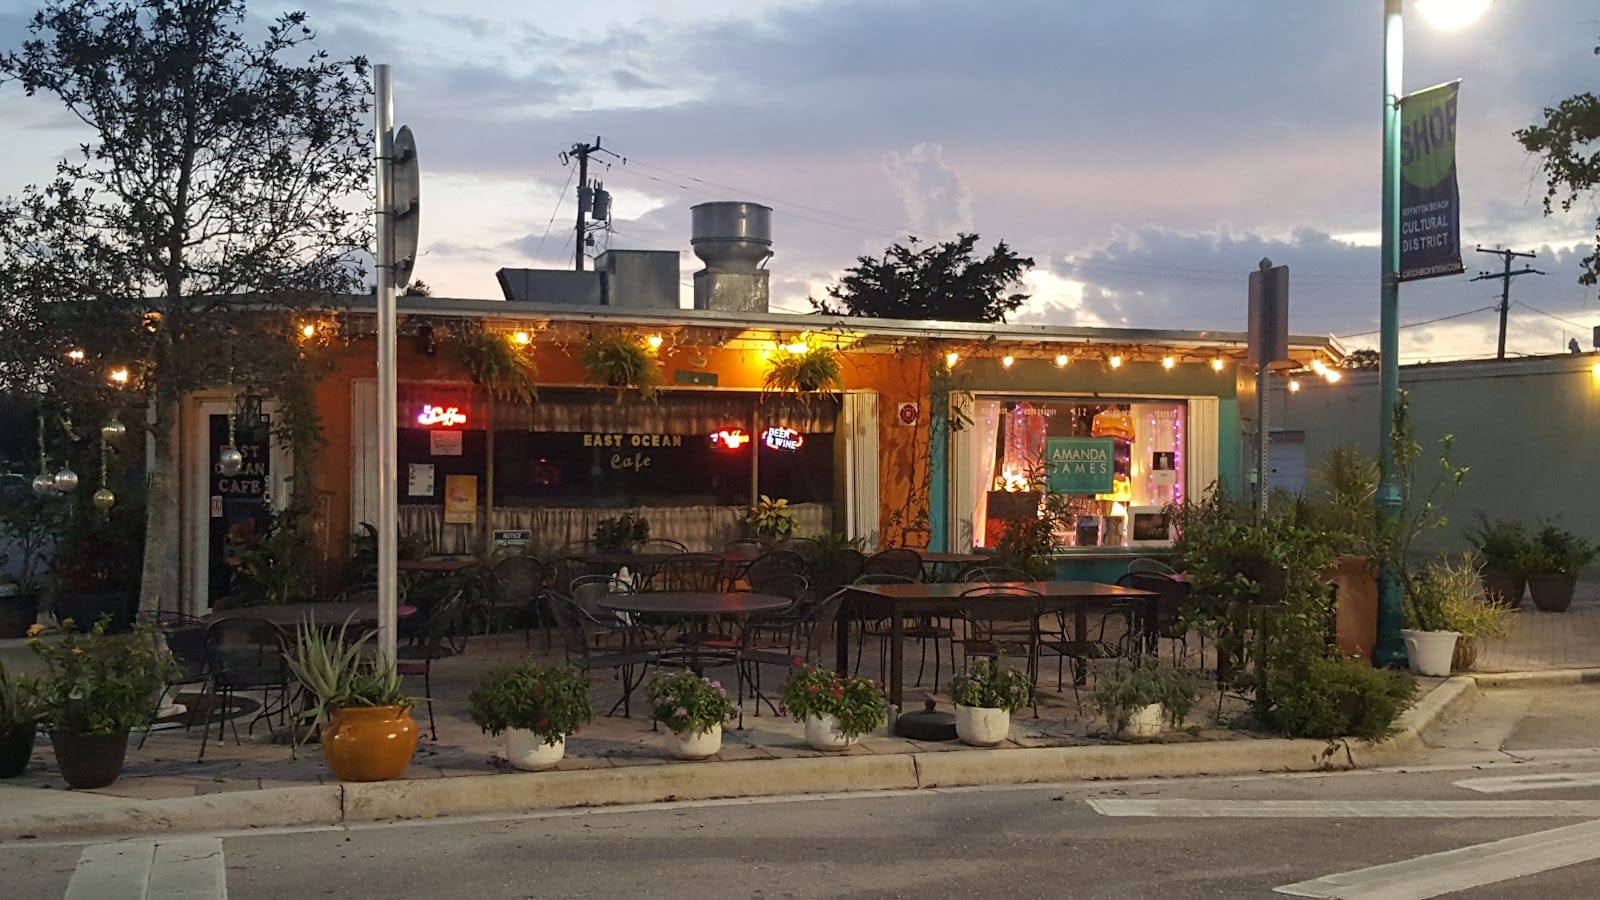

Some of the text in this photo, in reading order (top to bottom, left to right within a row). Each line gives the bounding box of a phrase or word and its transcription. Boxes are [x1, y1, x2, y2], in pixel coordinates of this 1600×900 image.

[1401, 101, 1457, 167] SHOP
[1402, 215, 1449, 235] CULTURAL
[1402, 232, 1449, 252] DISTRICT
[583, 434, 682, 447] EAST OCEAN
[775, 437, 798, 450] WINE
[220, 444, 260, 458] ST
[1052, 447, 1107, 460] AMANDA
[215, 462, 265, 475] OAN
[611, 453, 652, 472] Cafe
[1052, 463, 1107, 474] JAMES
[218, 479, 261, 494] CAFE
